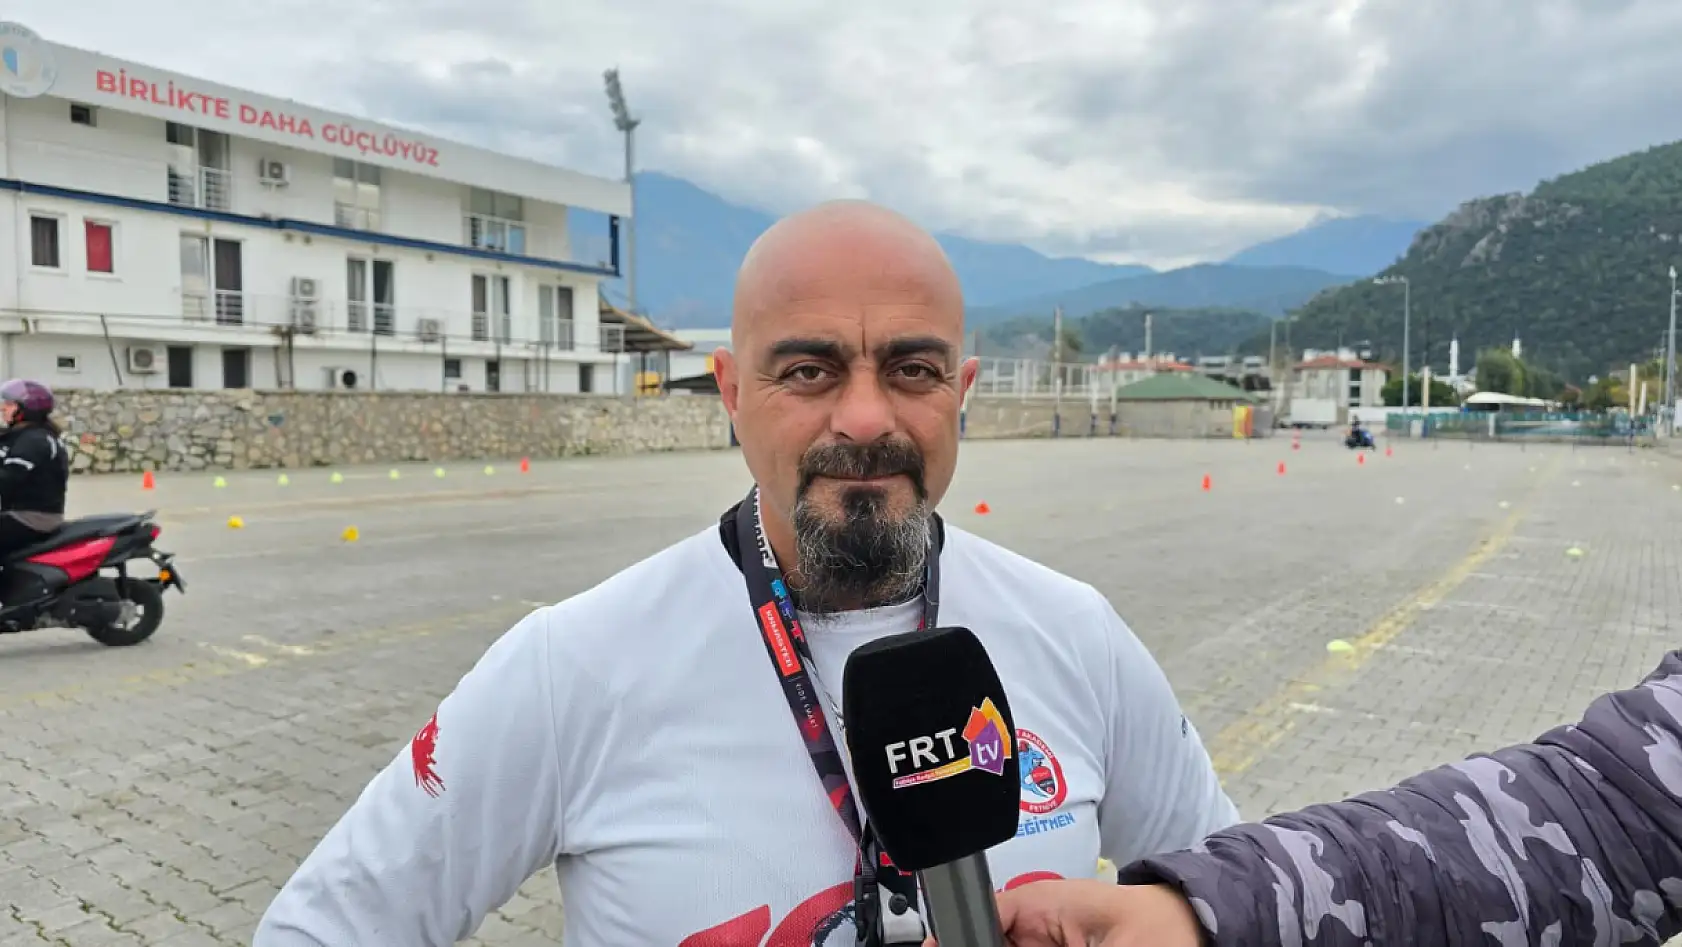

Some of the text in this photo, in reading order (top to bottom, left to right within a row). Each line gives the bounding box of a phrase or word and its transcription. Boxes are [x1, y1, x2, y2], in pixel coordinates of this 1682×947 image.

[96, 68, 440, 167] BİRLİKTE DAHA GÜÇLÜYÜZ
[885, 728, 957, 774] FRT
[976, 740, 999, 766] tv
